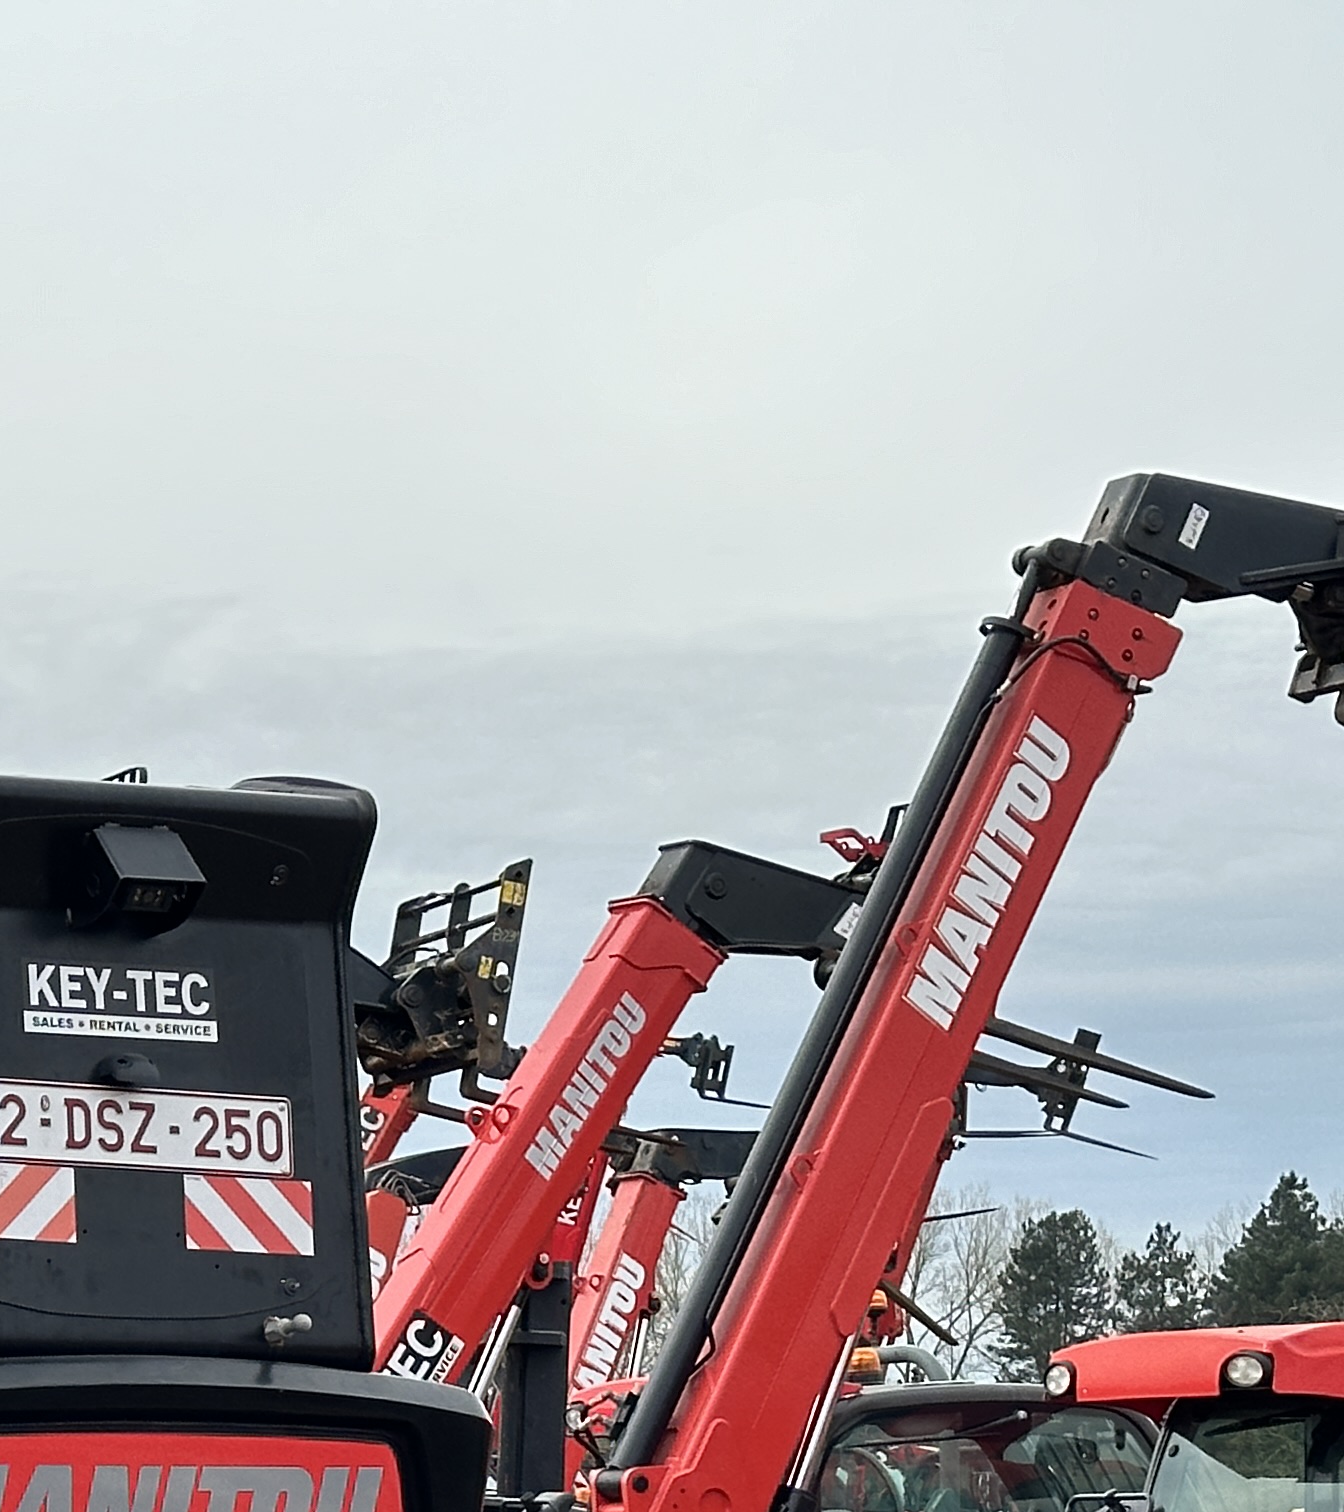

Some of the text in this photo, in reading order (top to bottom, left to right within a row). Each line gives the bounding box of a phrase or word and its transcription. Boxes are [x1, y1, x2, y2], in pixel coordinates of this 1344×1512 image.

[903, 711, 1071, 1031] MANITOU
[27, 963, 210, 1016] KEY-TEC
[32, 1016, 212, 1036] SALES RENTAL SERVICE
[523, 991, 648, 1181] MANITOU
[432, 1342, 459, 1383] RVICE
[574, 1250, 646, 1389] ANITOU
